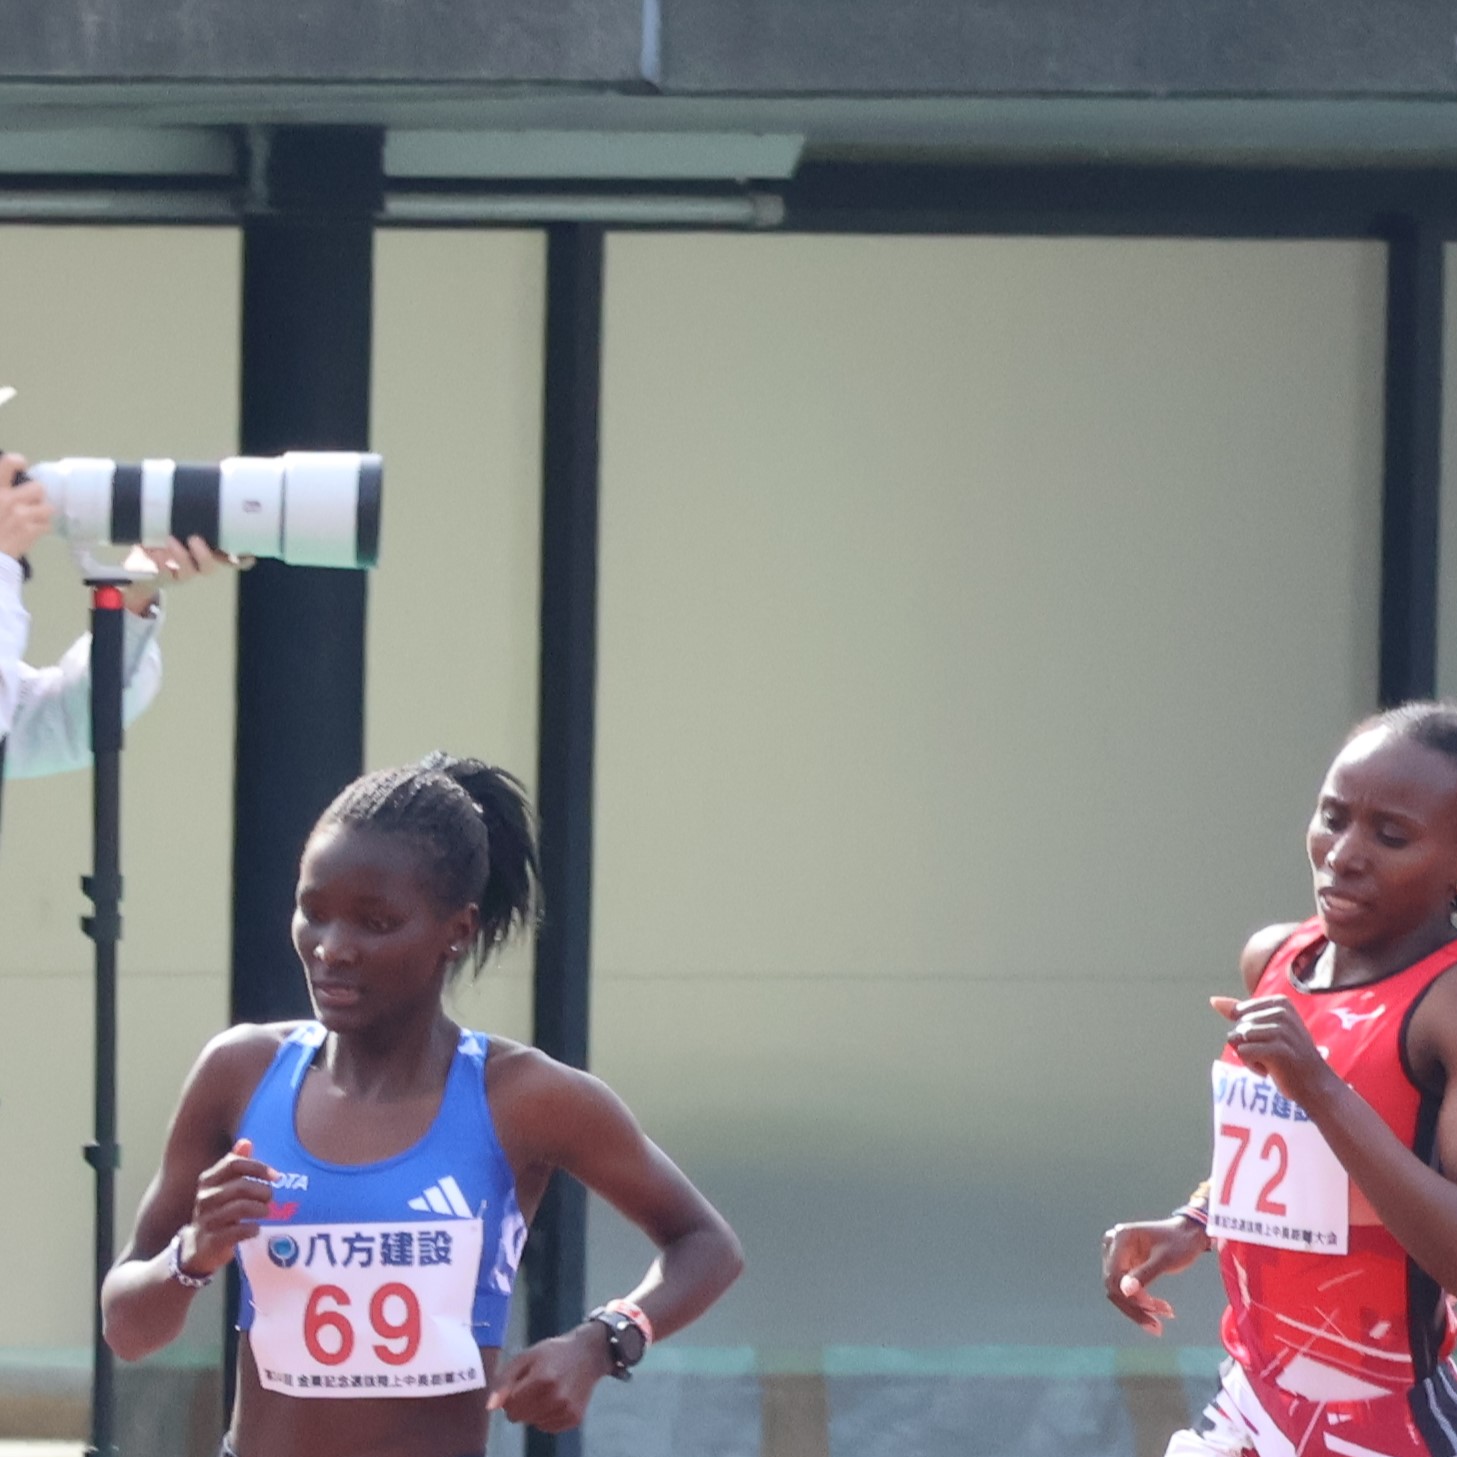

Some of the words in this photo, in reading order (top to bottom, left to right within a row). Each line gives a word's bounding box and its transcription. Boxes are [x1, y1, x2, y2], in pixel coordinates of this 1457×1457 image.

[1226, 1077, 1311, 1122] 八方建
[1219, 1122, 1289, 1217] 72
[304, 1231, 452, 1268] 八方建設
[304, 1282, 422, 1366] 69
